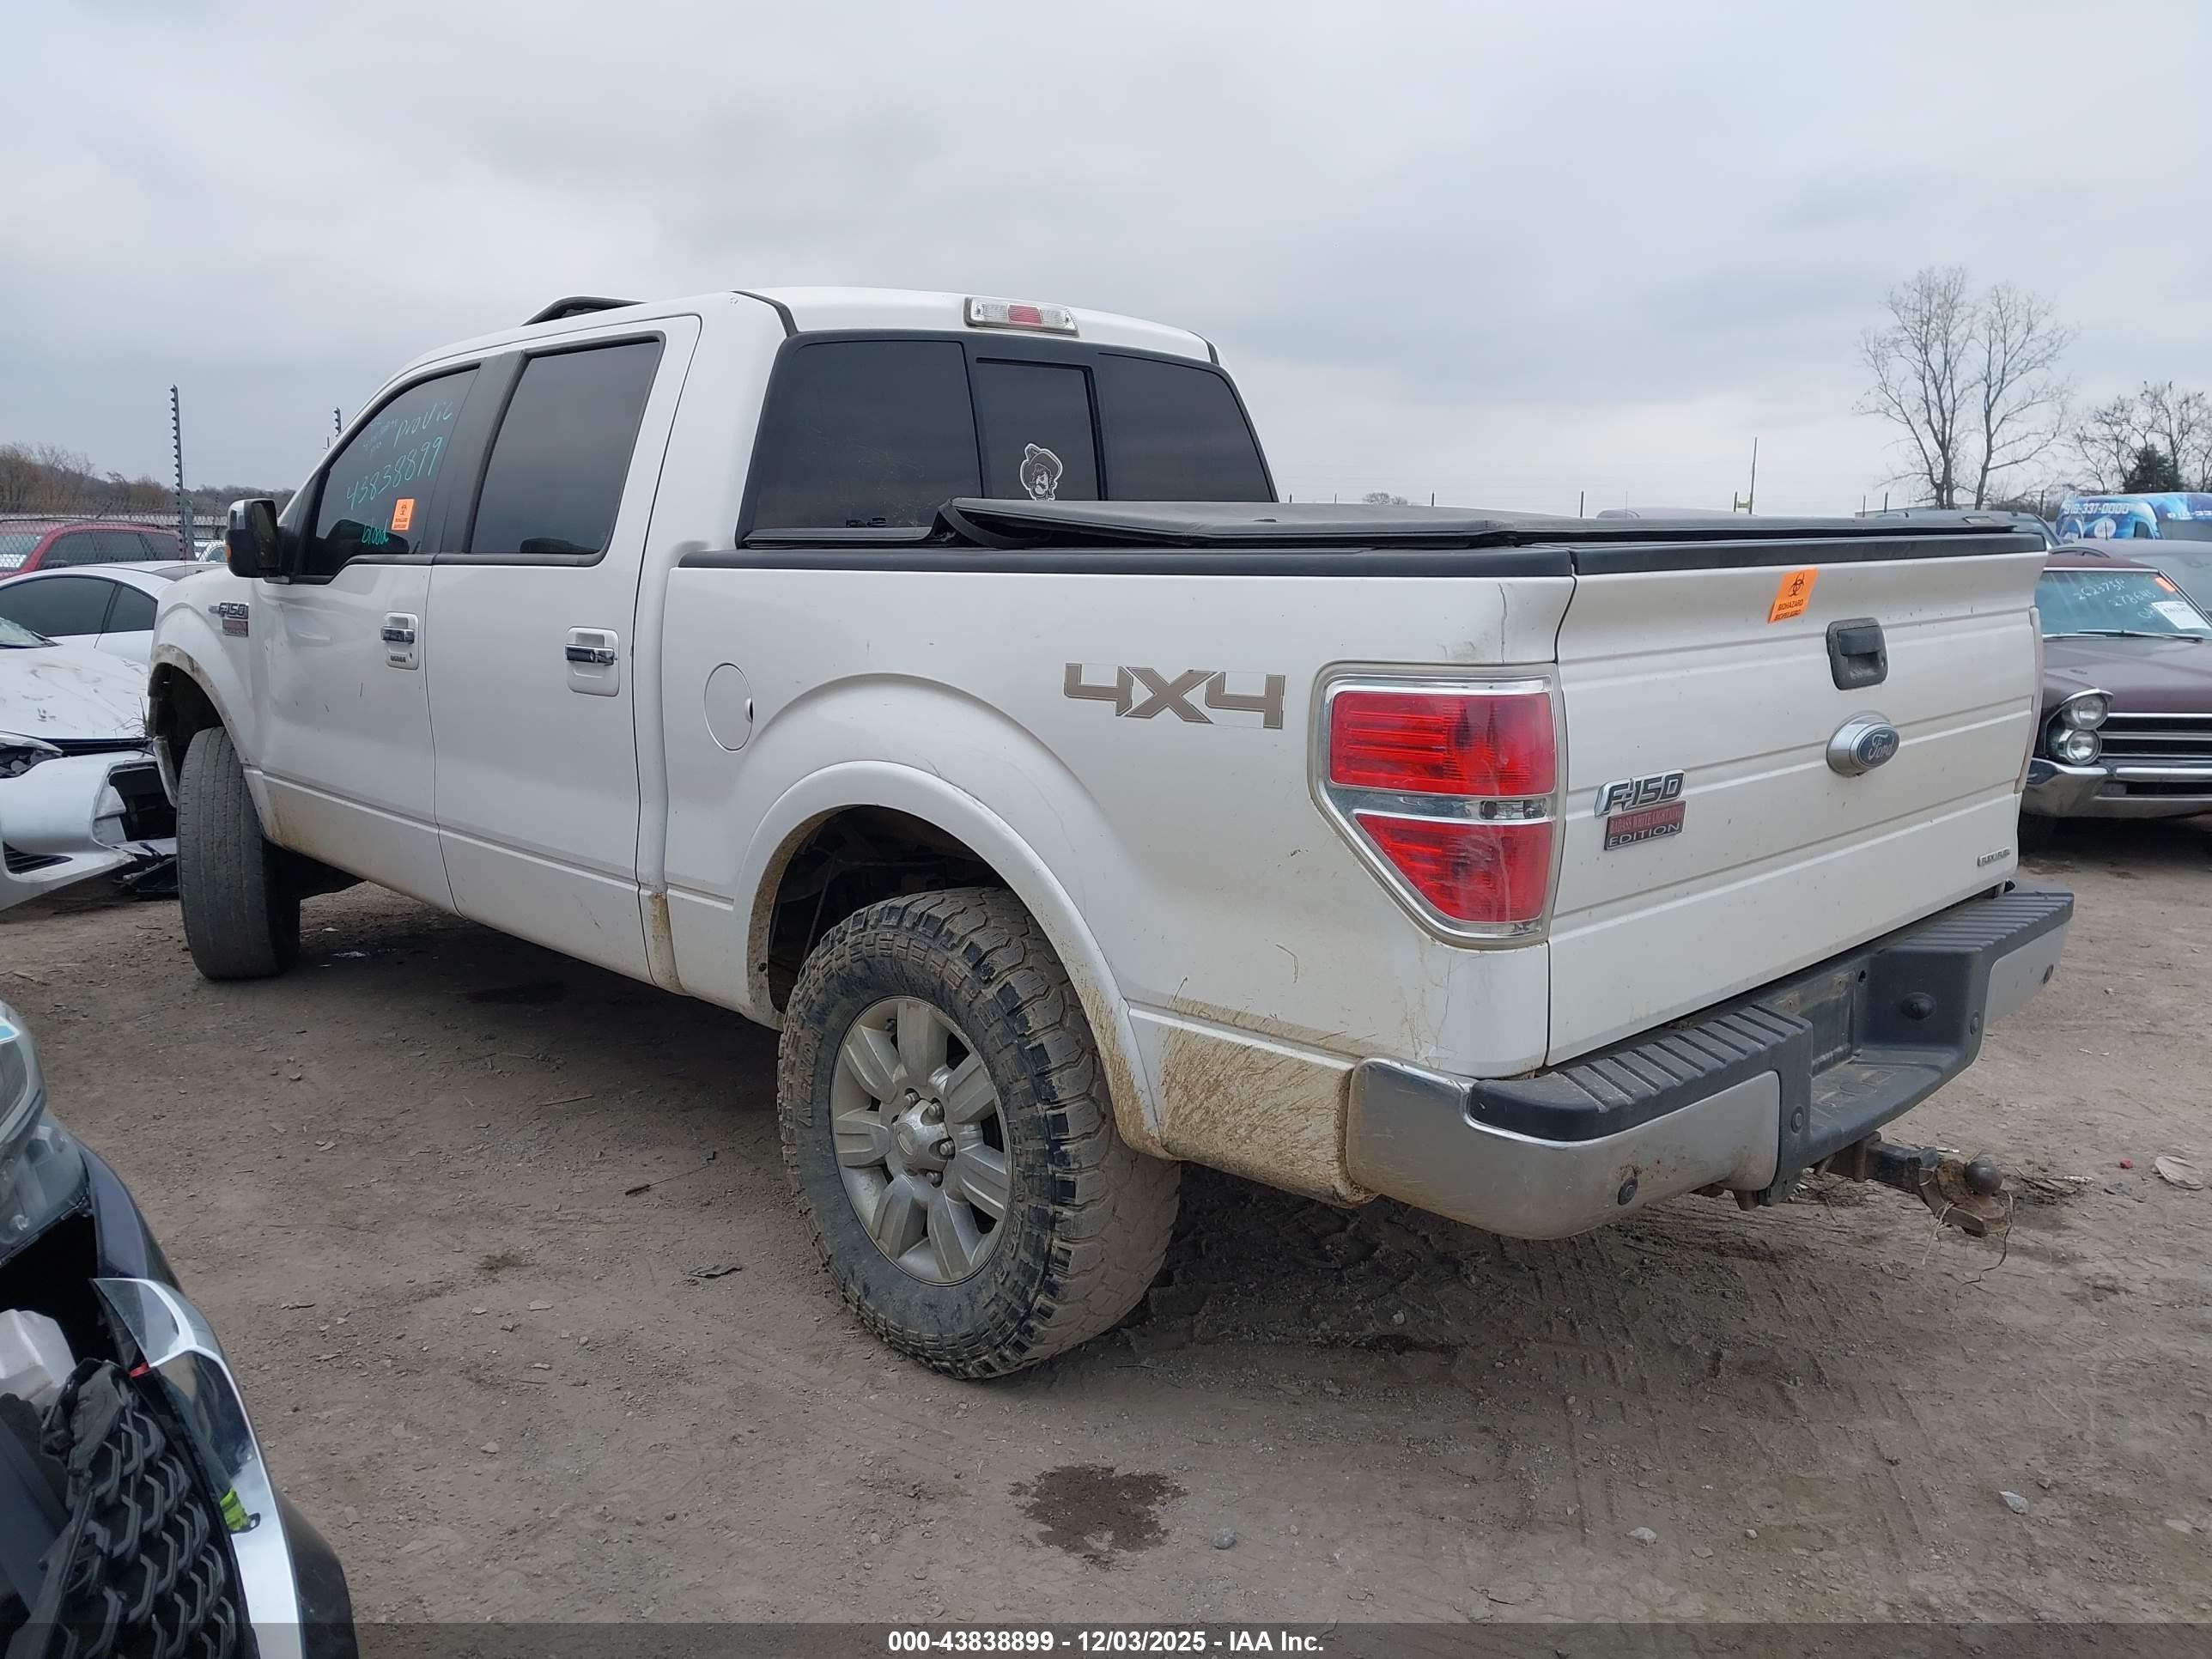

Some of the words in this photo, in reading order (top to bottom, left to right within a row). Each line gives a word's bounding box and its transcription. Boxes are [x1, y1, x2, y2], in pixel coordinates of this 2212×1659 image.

[346, 435, 443, 510] 43838899
[1778, 599, 1804, 611] BIOHAZARD
[1868, 732, 1895, 761] Ford
[1602, 771, 1685, 815] F-150
[1608, 822, 1680, 847] EDITION
